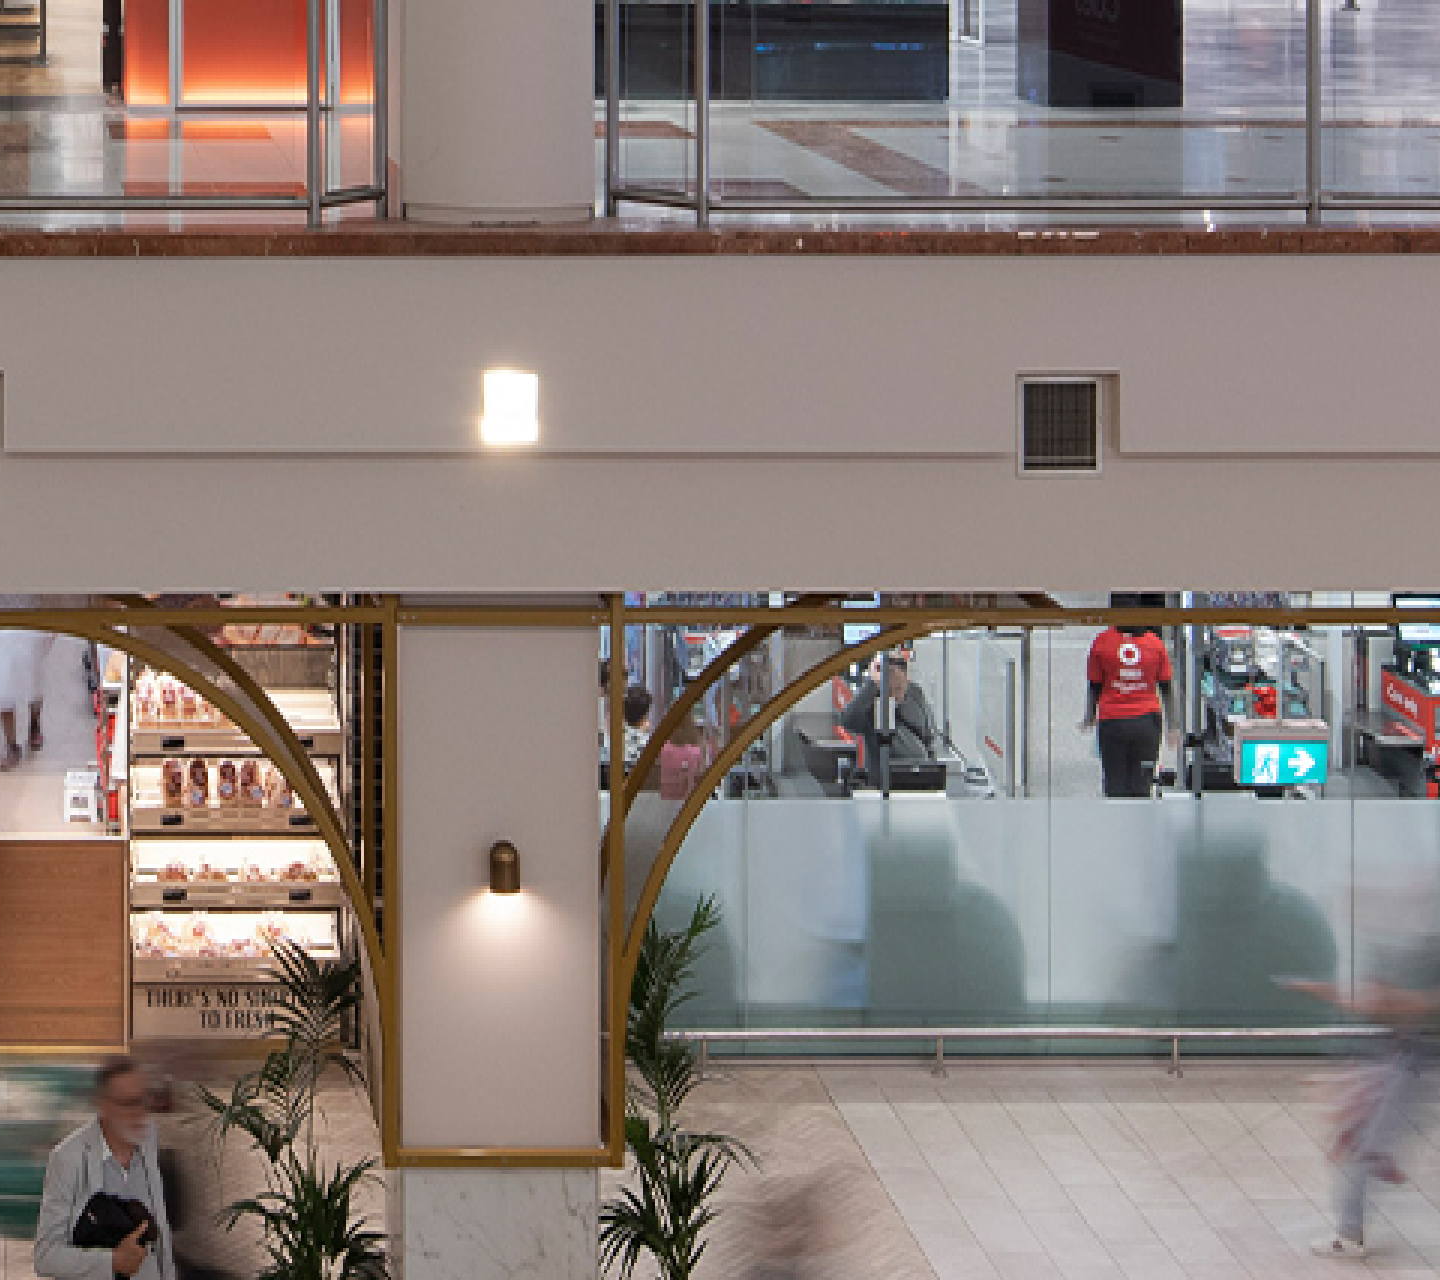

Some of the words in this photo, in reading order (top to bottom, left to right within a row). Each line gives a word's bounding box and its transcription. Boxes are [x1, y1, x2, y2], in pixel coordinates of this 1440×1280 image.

[146, 988, 210, 1008] THERE'S
[216, 988, 239, 1008] NO
[200, 1009, 221, 1029] TO
